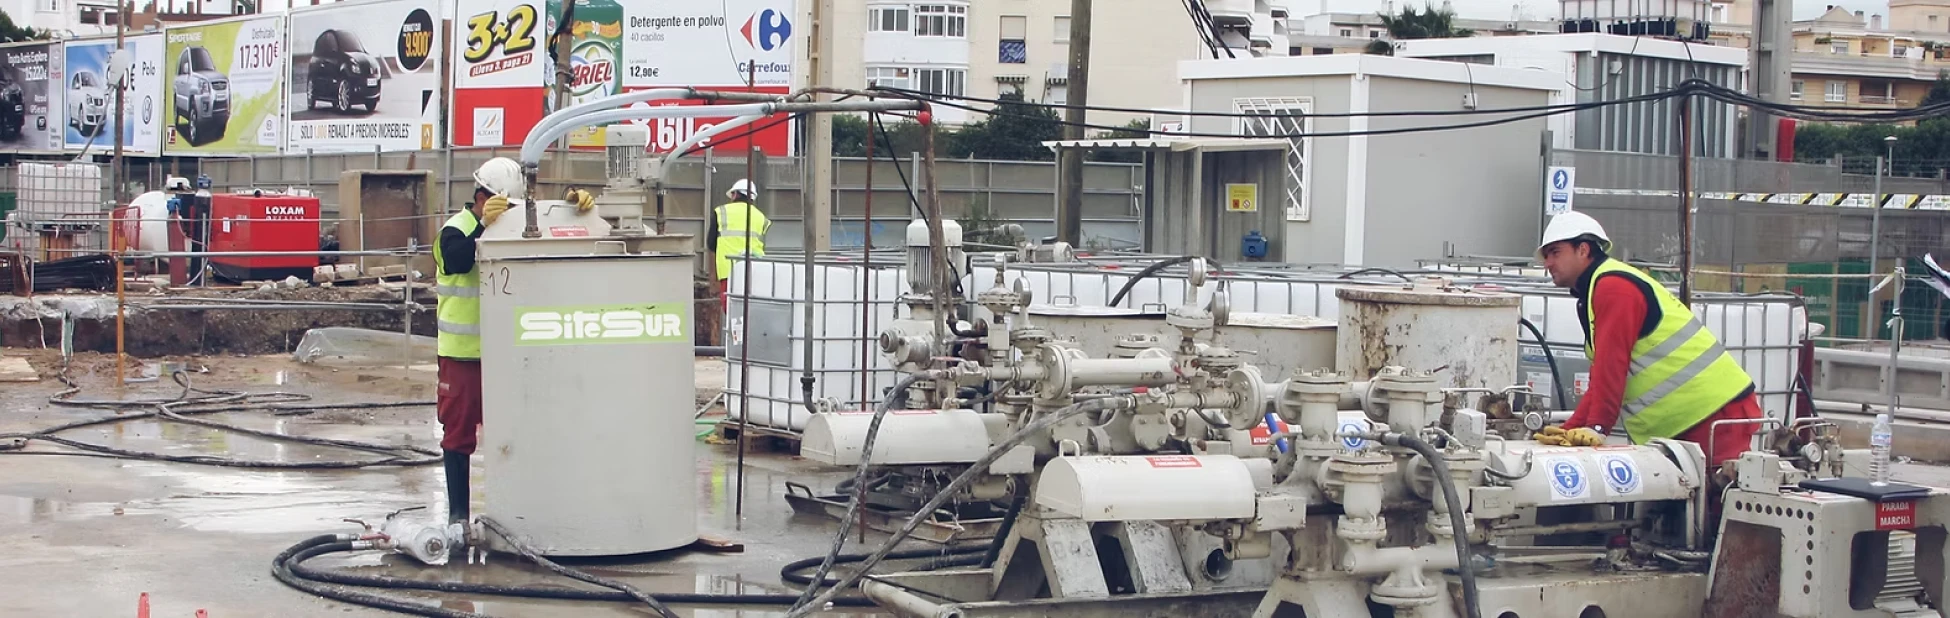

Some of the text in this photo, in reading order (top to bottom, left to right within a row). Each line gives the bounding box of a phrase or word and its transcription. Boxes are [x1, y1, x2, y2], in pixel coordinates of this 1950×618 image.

[630, 15, 724, 30] Detergente en polvo
[631, 33, 639, 41] 40
[240, 41, 279, 69] 17.310€
[142, 60, 156, 76] Polo
[630, 66, 659, 78] 12,90€
[570, 62, 612, 88] ARIEL
[328, 124, 350, 139] RENAULT
[355, 124, 378, 139] PRECIOS
[265, 206, 304, 215] LOXAM
[1882, 501, 1910, 512] PARADA
[1880, 515, 1911, 526] MARCHA
